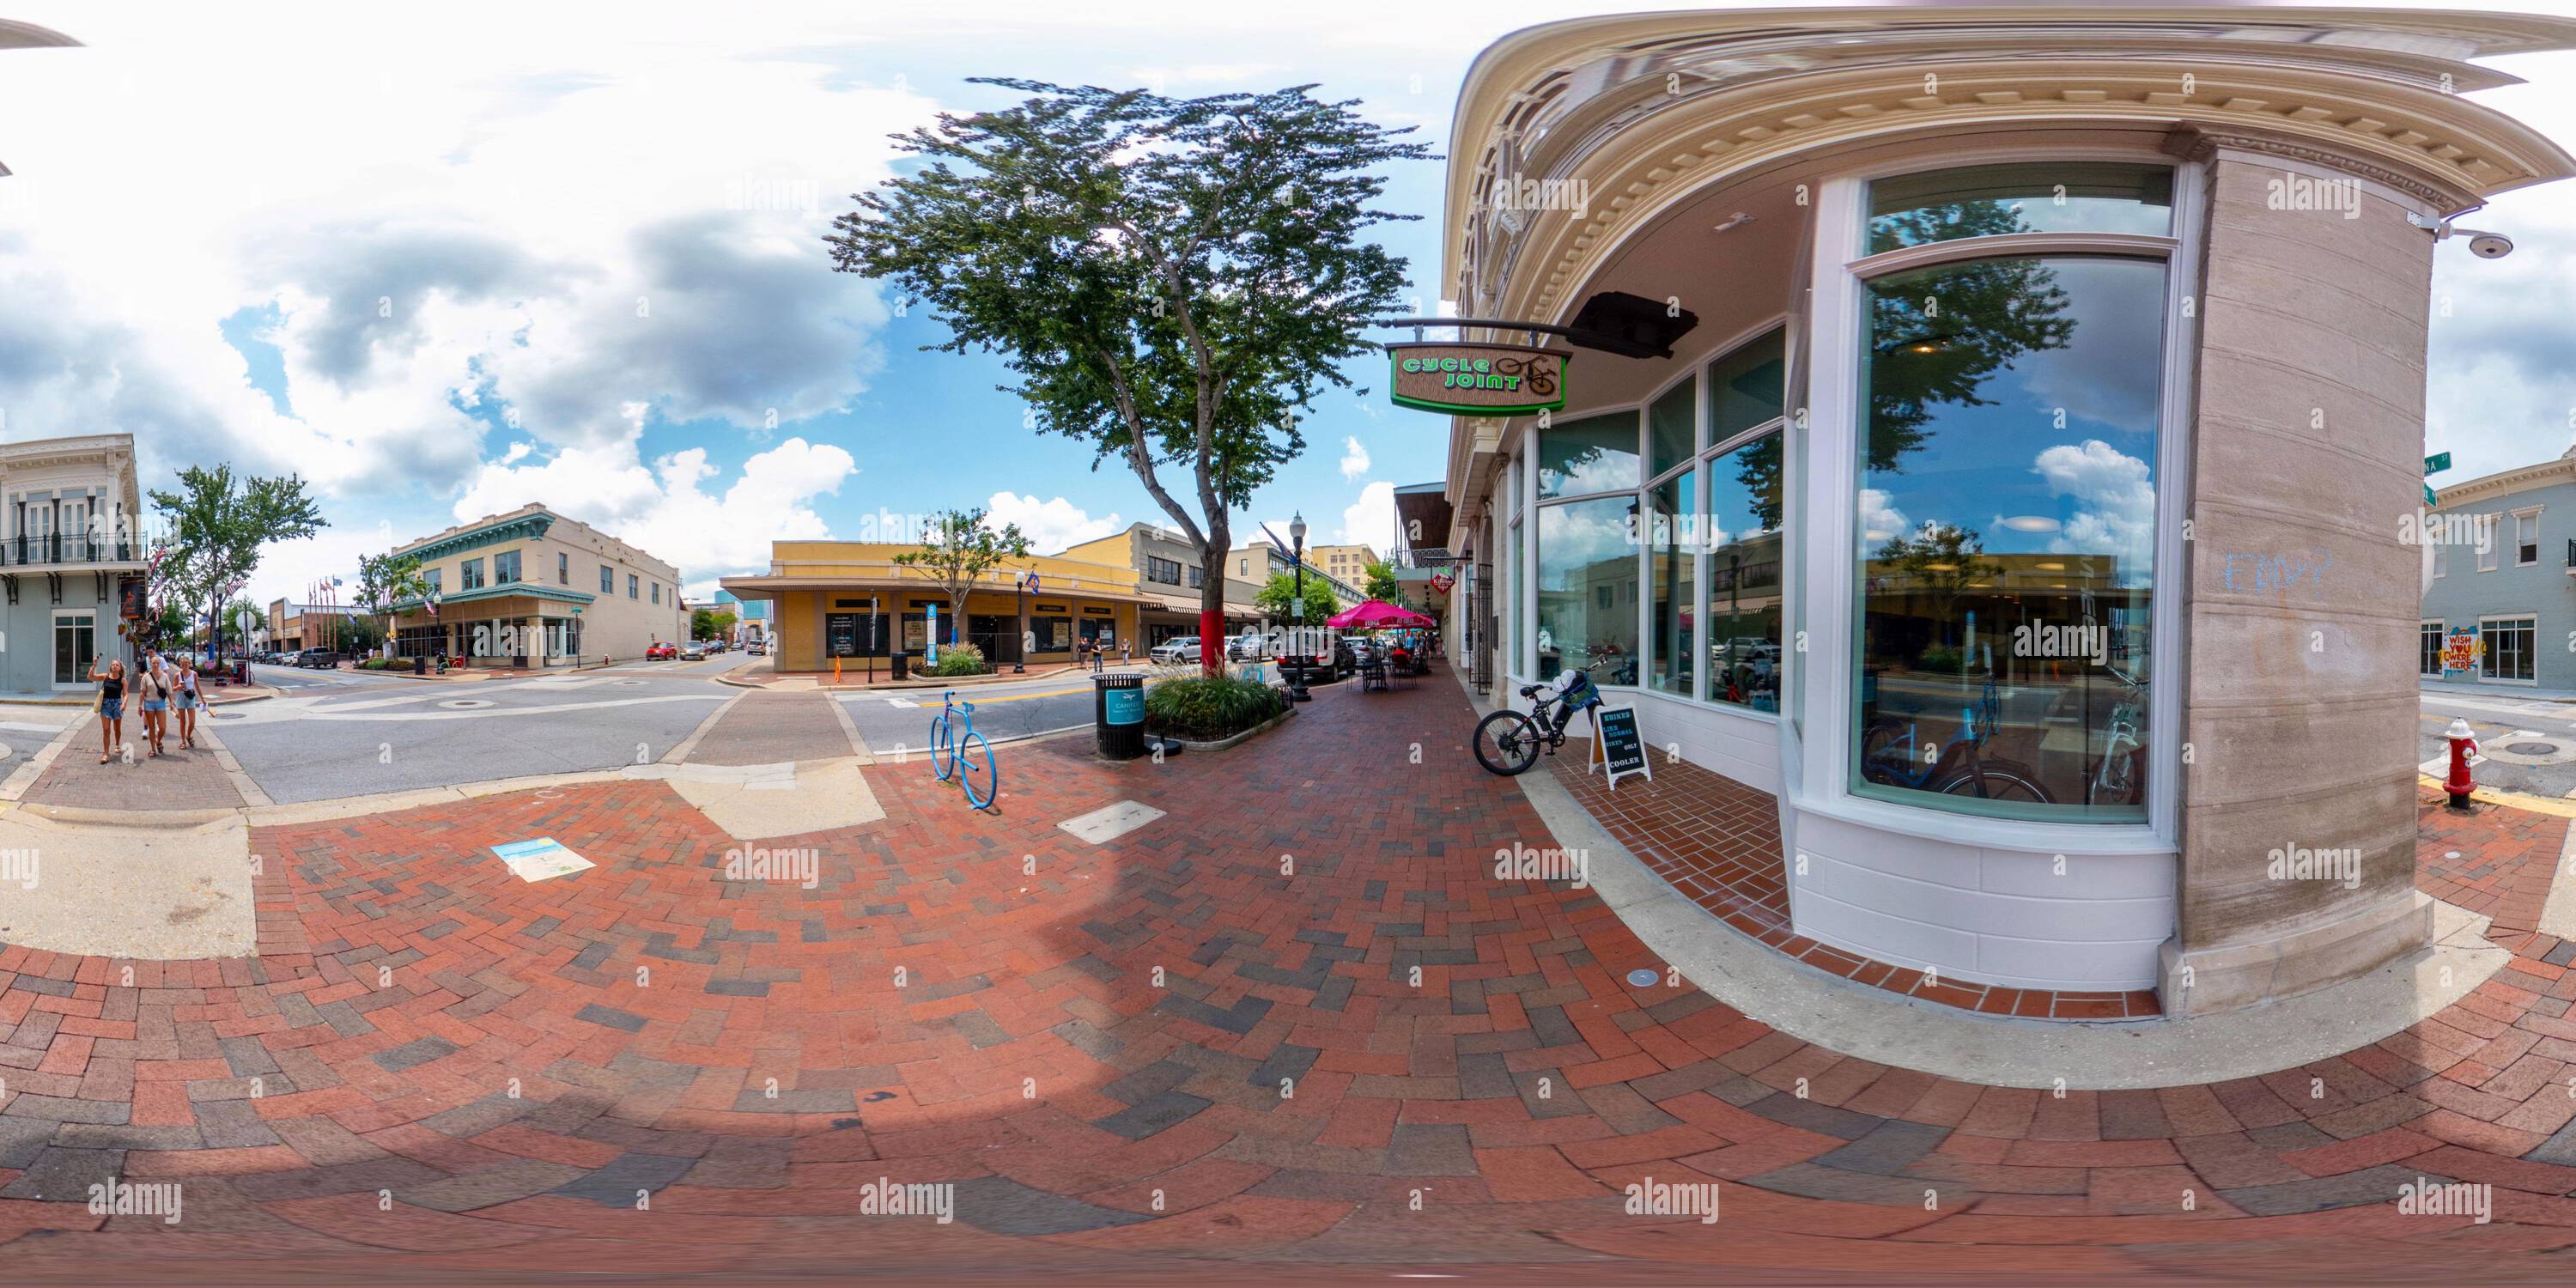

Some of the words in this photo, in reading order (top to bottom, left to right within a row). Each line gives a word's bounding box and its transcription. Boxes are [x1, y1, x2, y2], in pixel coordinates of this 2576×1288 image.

[1444, 373, 1522, 392] JOINT
[2449, 635, 2471, 644] WISH
[2449, 661, 2471, 671] HERE
[1609, 756, 1639, 768] COOLER
